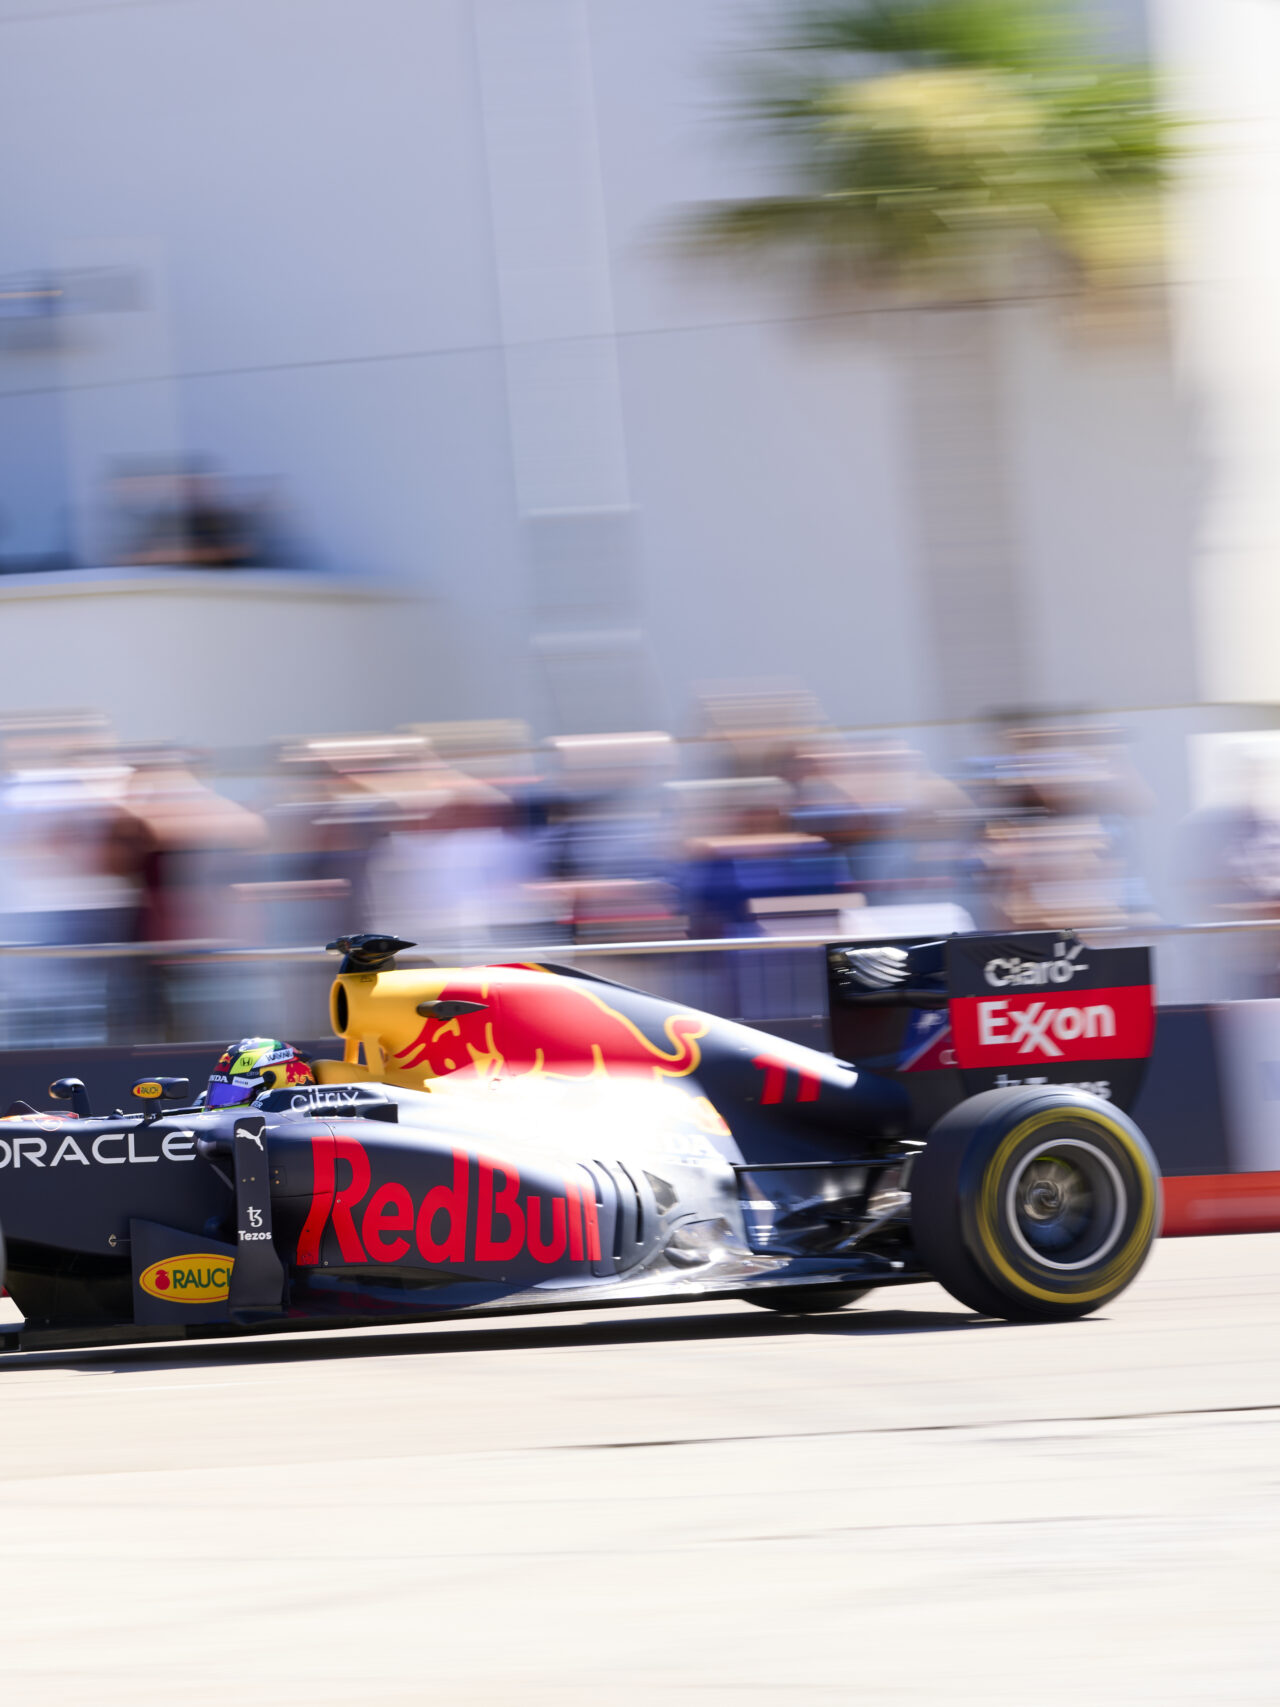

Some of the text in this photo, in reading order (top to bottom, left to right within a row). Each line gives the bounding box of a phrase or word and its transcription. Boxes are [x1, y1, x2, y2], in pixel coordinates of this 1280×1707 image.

[977, 1000, 1116, 1057] Exxon
[290, 1085, 359, 1113] citrix
[238, 1230, 272, 1241] Tezos
